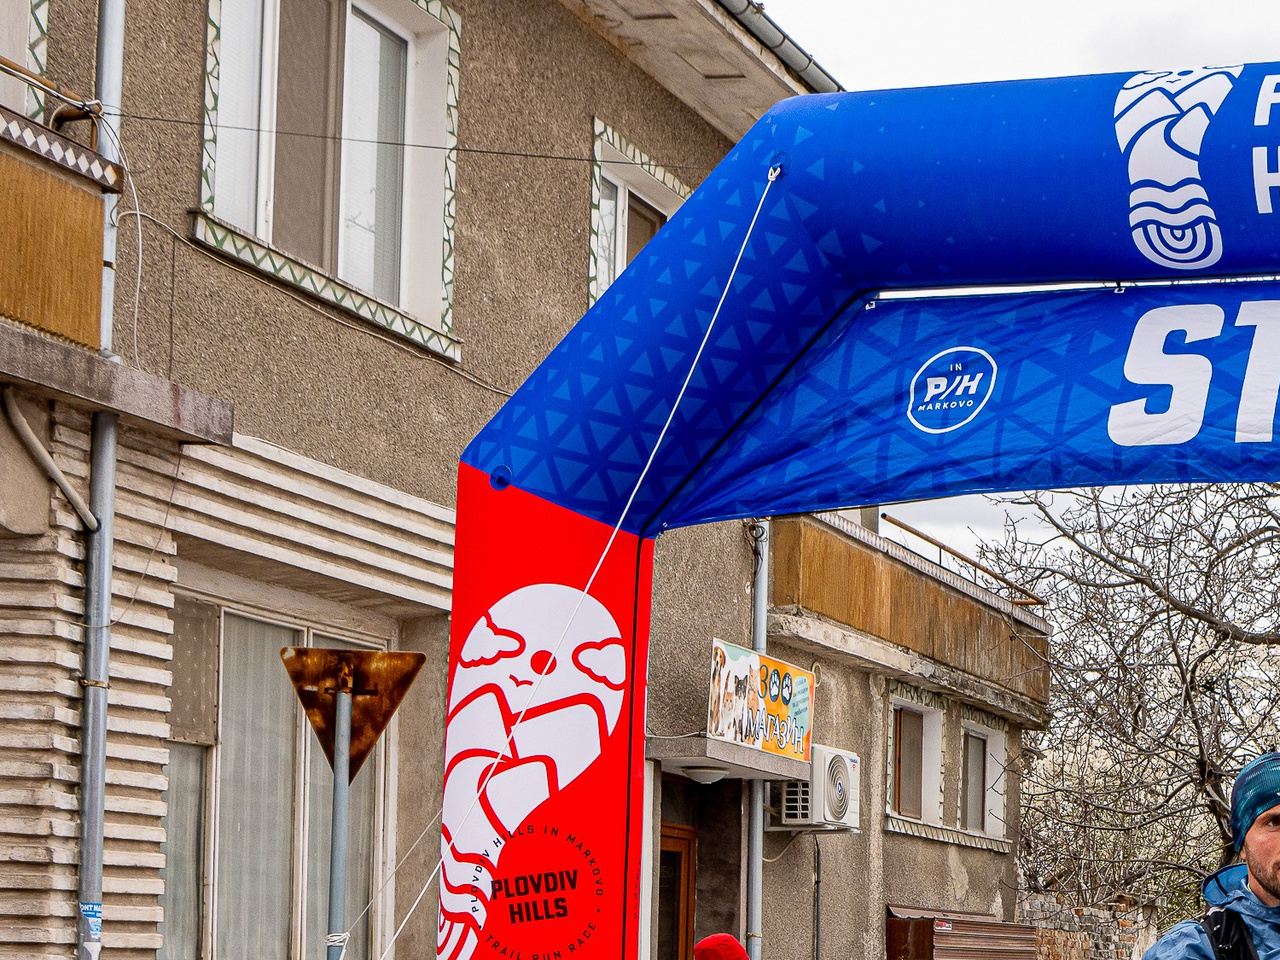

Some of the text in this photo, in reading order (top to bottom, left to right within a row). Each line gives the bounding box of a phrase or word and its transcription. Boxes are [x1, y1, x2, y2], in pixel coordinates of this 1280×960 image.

[950, 363, 962, 372] IN
[917, 399, 974, 412] MARKOVO
[746, 707, 804, 753] МАГАЗИН
[470, 850, 490, 913] PLOVDIV
[492, 825, 535, 848] HILLS
[544, 825, 559, 837] IN
[566, 833, 604, 896] MARKOVO
[491, 868, 579, 900] PLOVDIV
[508, 897, 569, 924] HILLS
[568, 922, 597, 953] RACE
